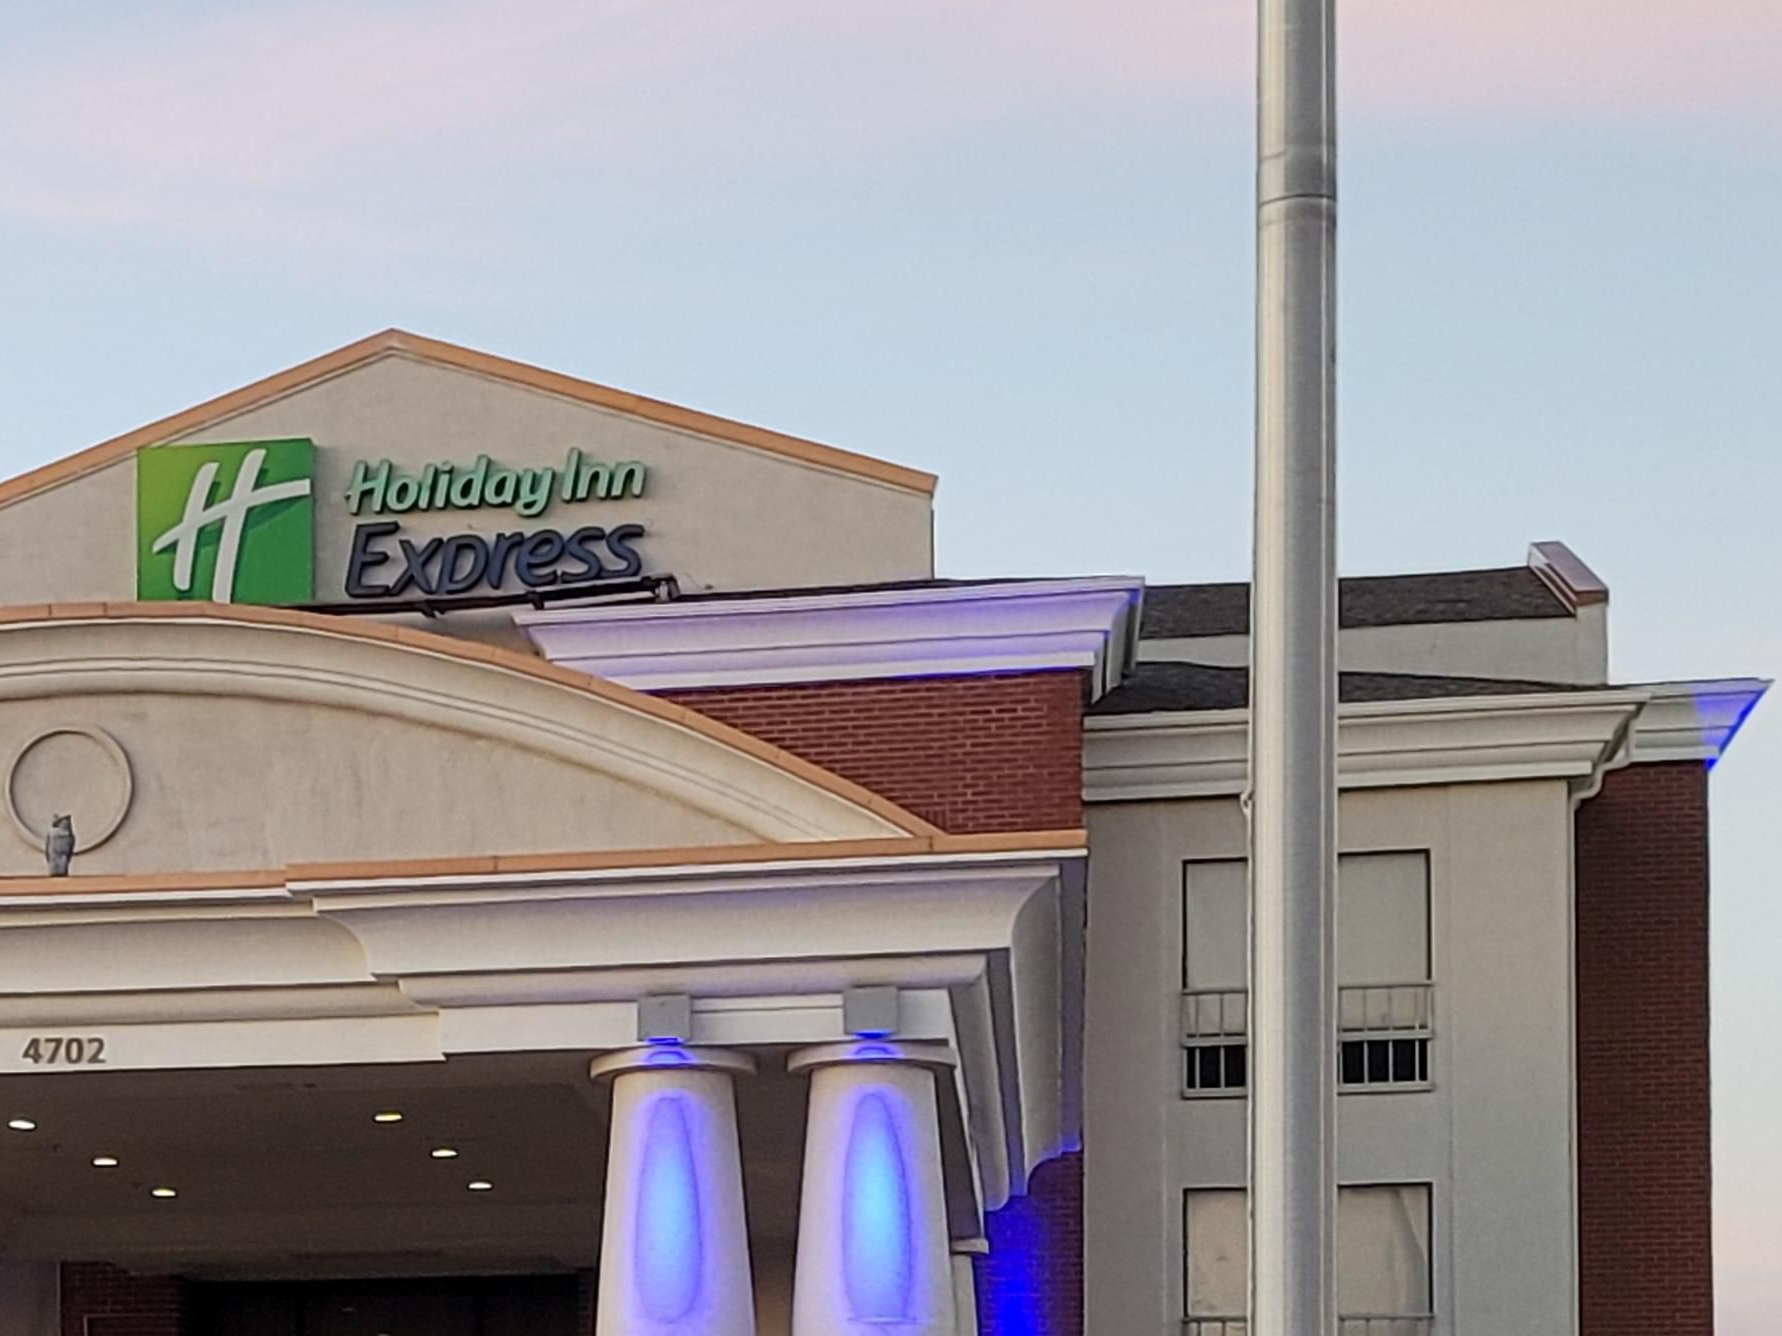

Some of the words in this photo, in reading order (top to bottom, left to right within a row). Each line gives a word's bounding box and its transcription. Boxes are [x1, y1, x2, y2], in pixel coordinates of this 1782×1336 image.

[345, 454, 556, 518] Holiday
[561, 446, 647, 504] Inn
[344, 520, 646, 598] Express
[21, 1036, 107, 1065] 4702
